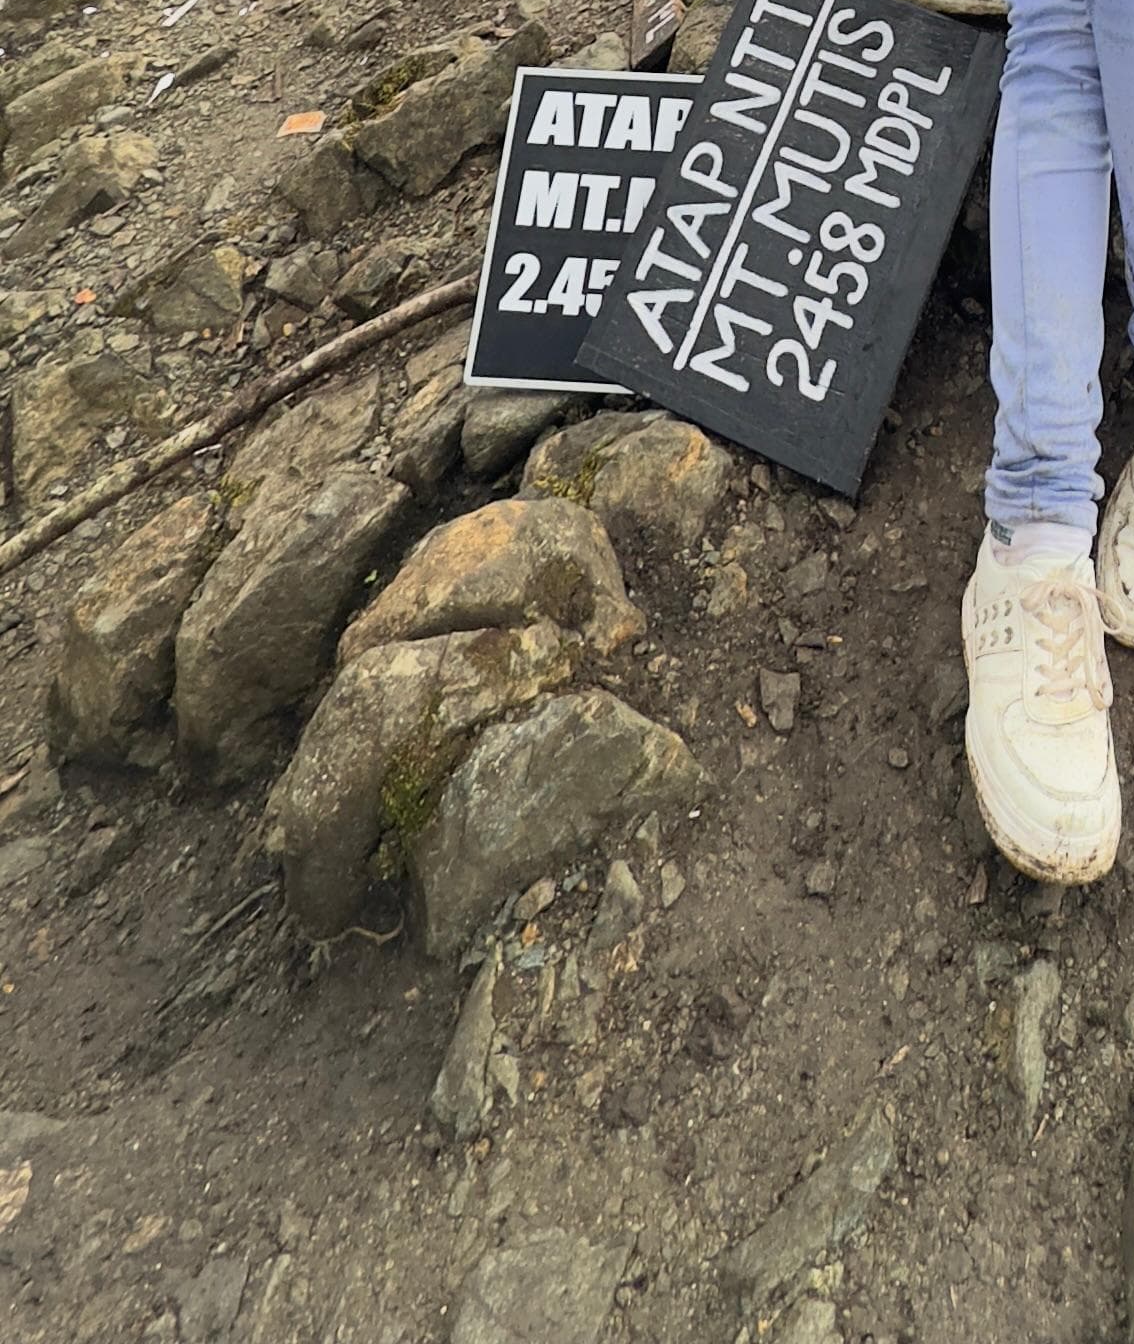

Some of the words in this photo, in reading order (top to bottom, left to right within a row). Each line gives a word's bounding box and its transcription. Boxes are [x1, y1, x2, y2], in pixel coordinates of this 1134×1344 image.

[526, 90, 694, 153] ATAP
[626, 141, 739, 354] ATAP
[689, 8, 896, 393] MT.MUTIS
[766, 211, 886, 402] 2458
[844, 66, 953, 209] MDPL
